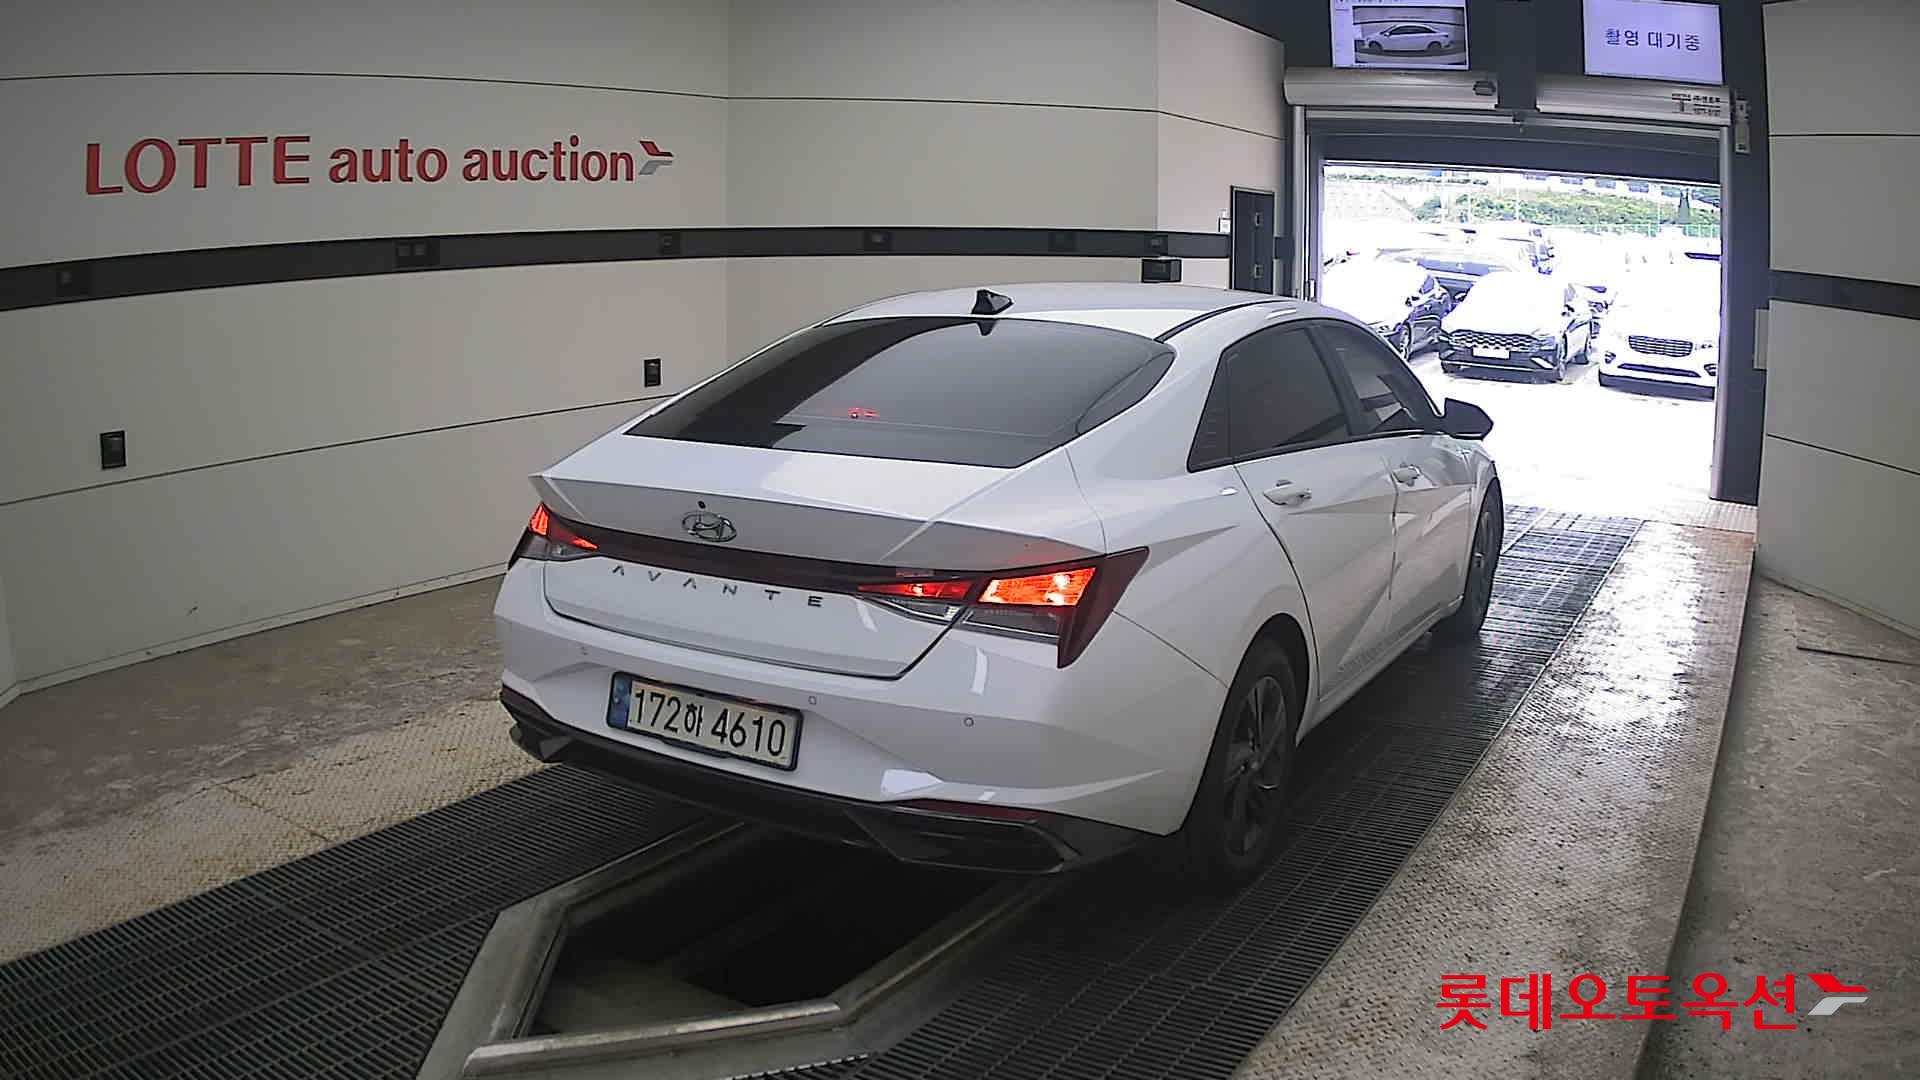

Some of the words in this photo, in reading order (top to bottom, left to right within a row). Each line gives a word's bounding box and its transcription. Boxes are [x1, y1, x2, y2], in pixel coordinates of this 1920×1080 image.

[1606, 28, 1639, 46] 촬영
[1647, 31, 1700, 51] 대기중
[85, 135, 310, 195] LOTTE
[328, 139, 448, 183] auto
[462, 134, 634, 182] auction
[612, 564, 823, 608] AVANTE
[635, 688, 703, 737] 172하
[711, 708, 786, 756] 4610
